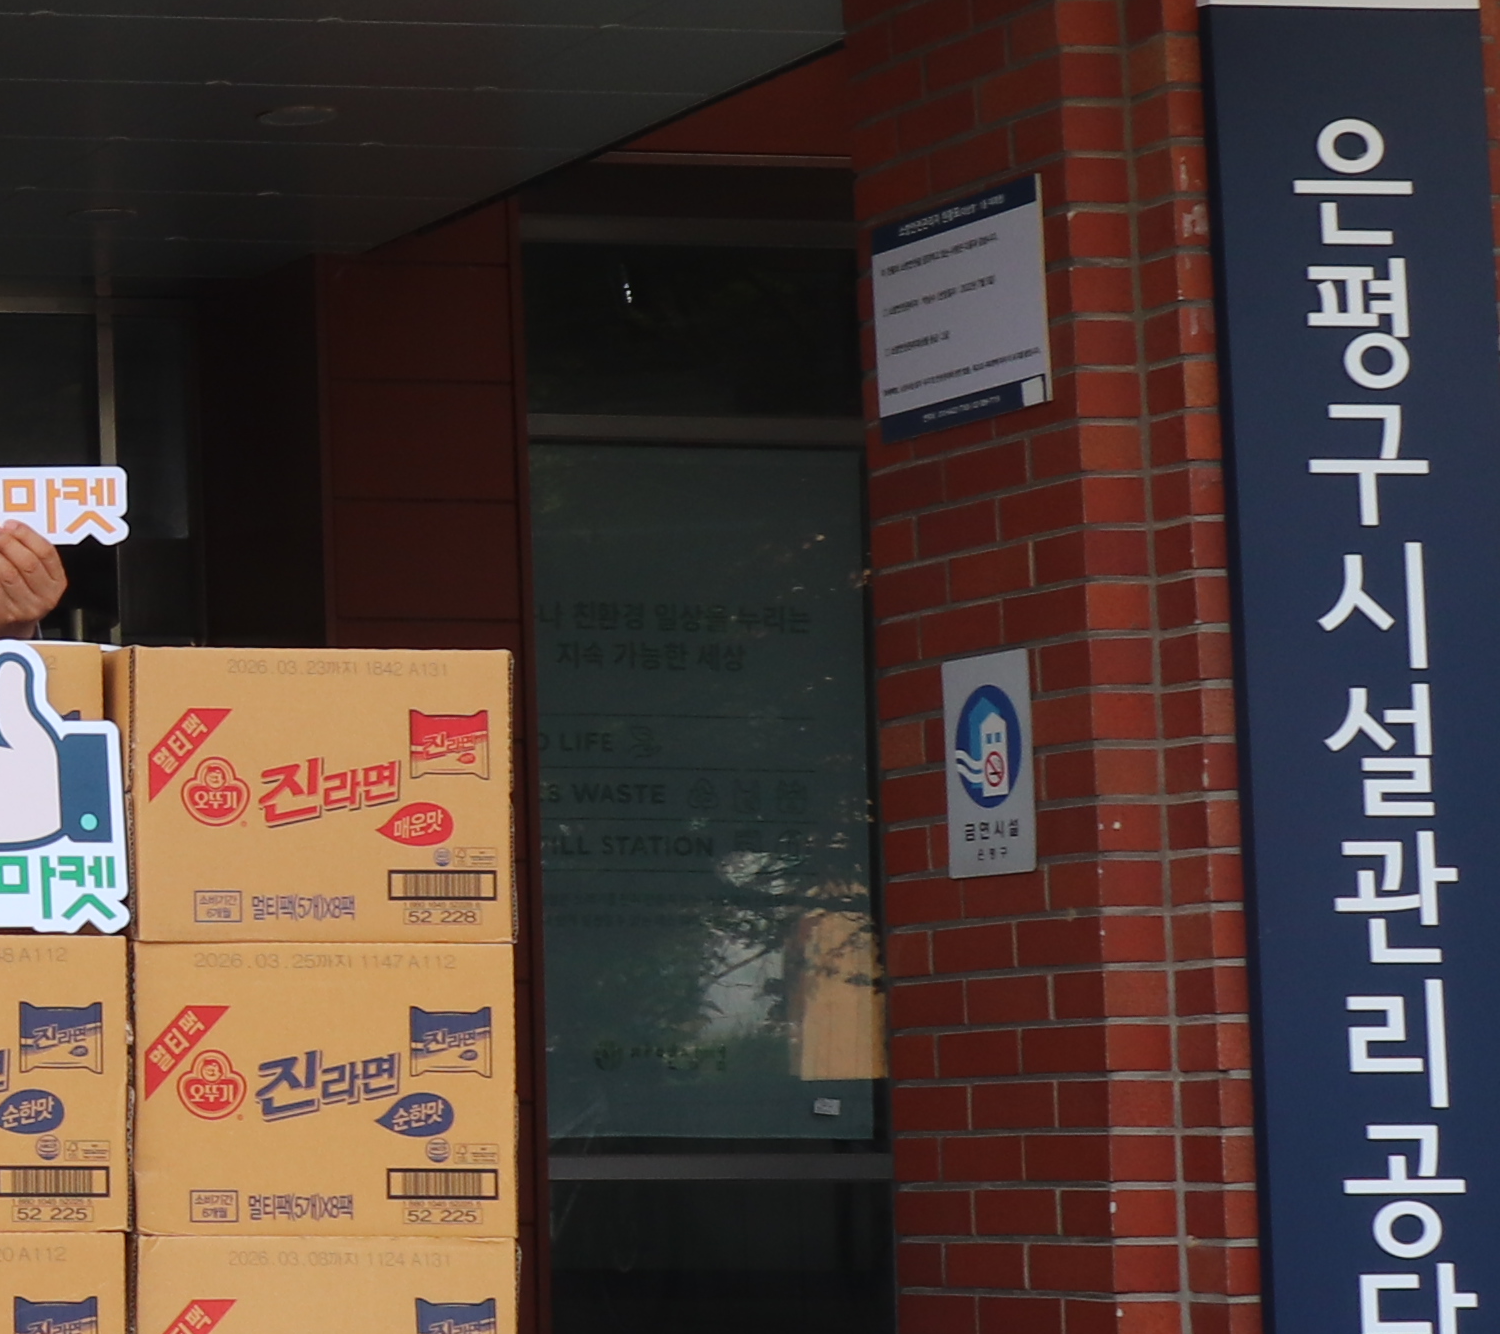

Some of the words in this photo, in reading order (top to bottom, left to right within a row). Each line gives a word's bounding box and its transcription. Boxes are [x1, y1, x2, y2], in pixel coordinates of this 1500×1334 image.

[256, 754, 403, 826] 진라면
[572, 784, 666, 805] WASTE
[603, 835, 714, 858] STATION
[254, 1049, 402, 1122] 진라면
